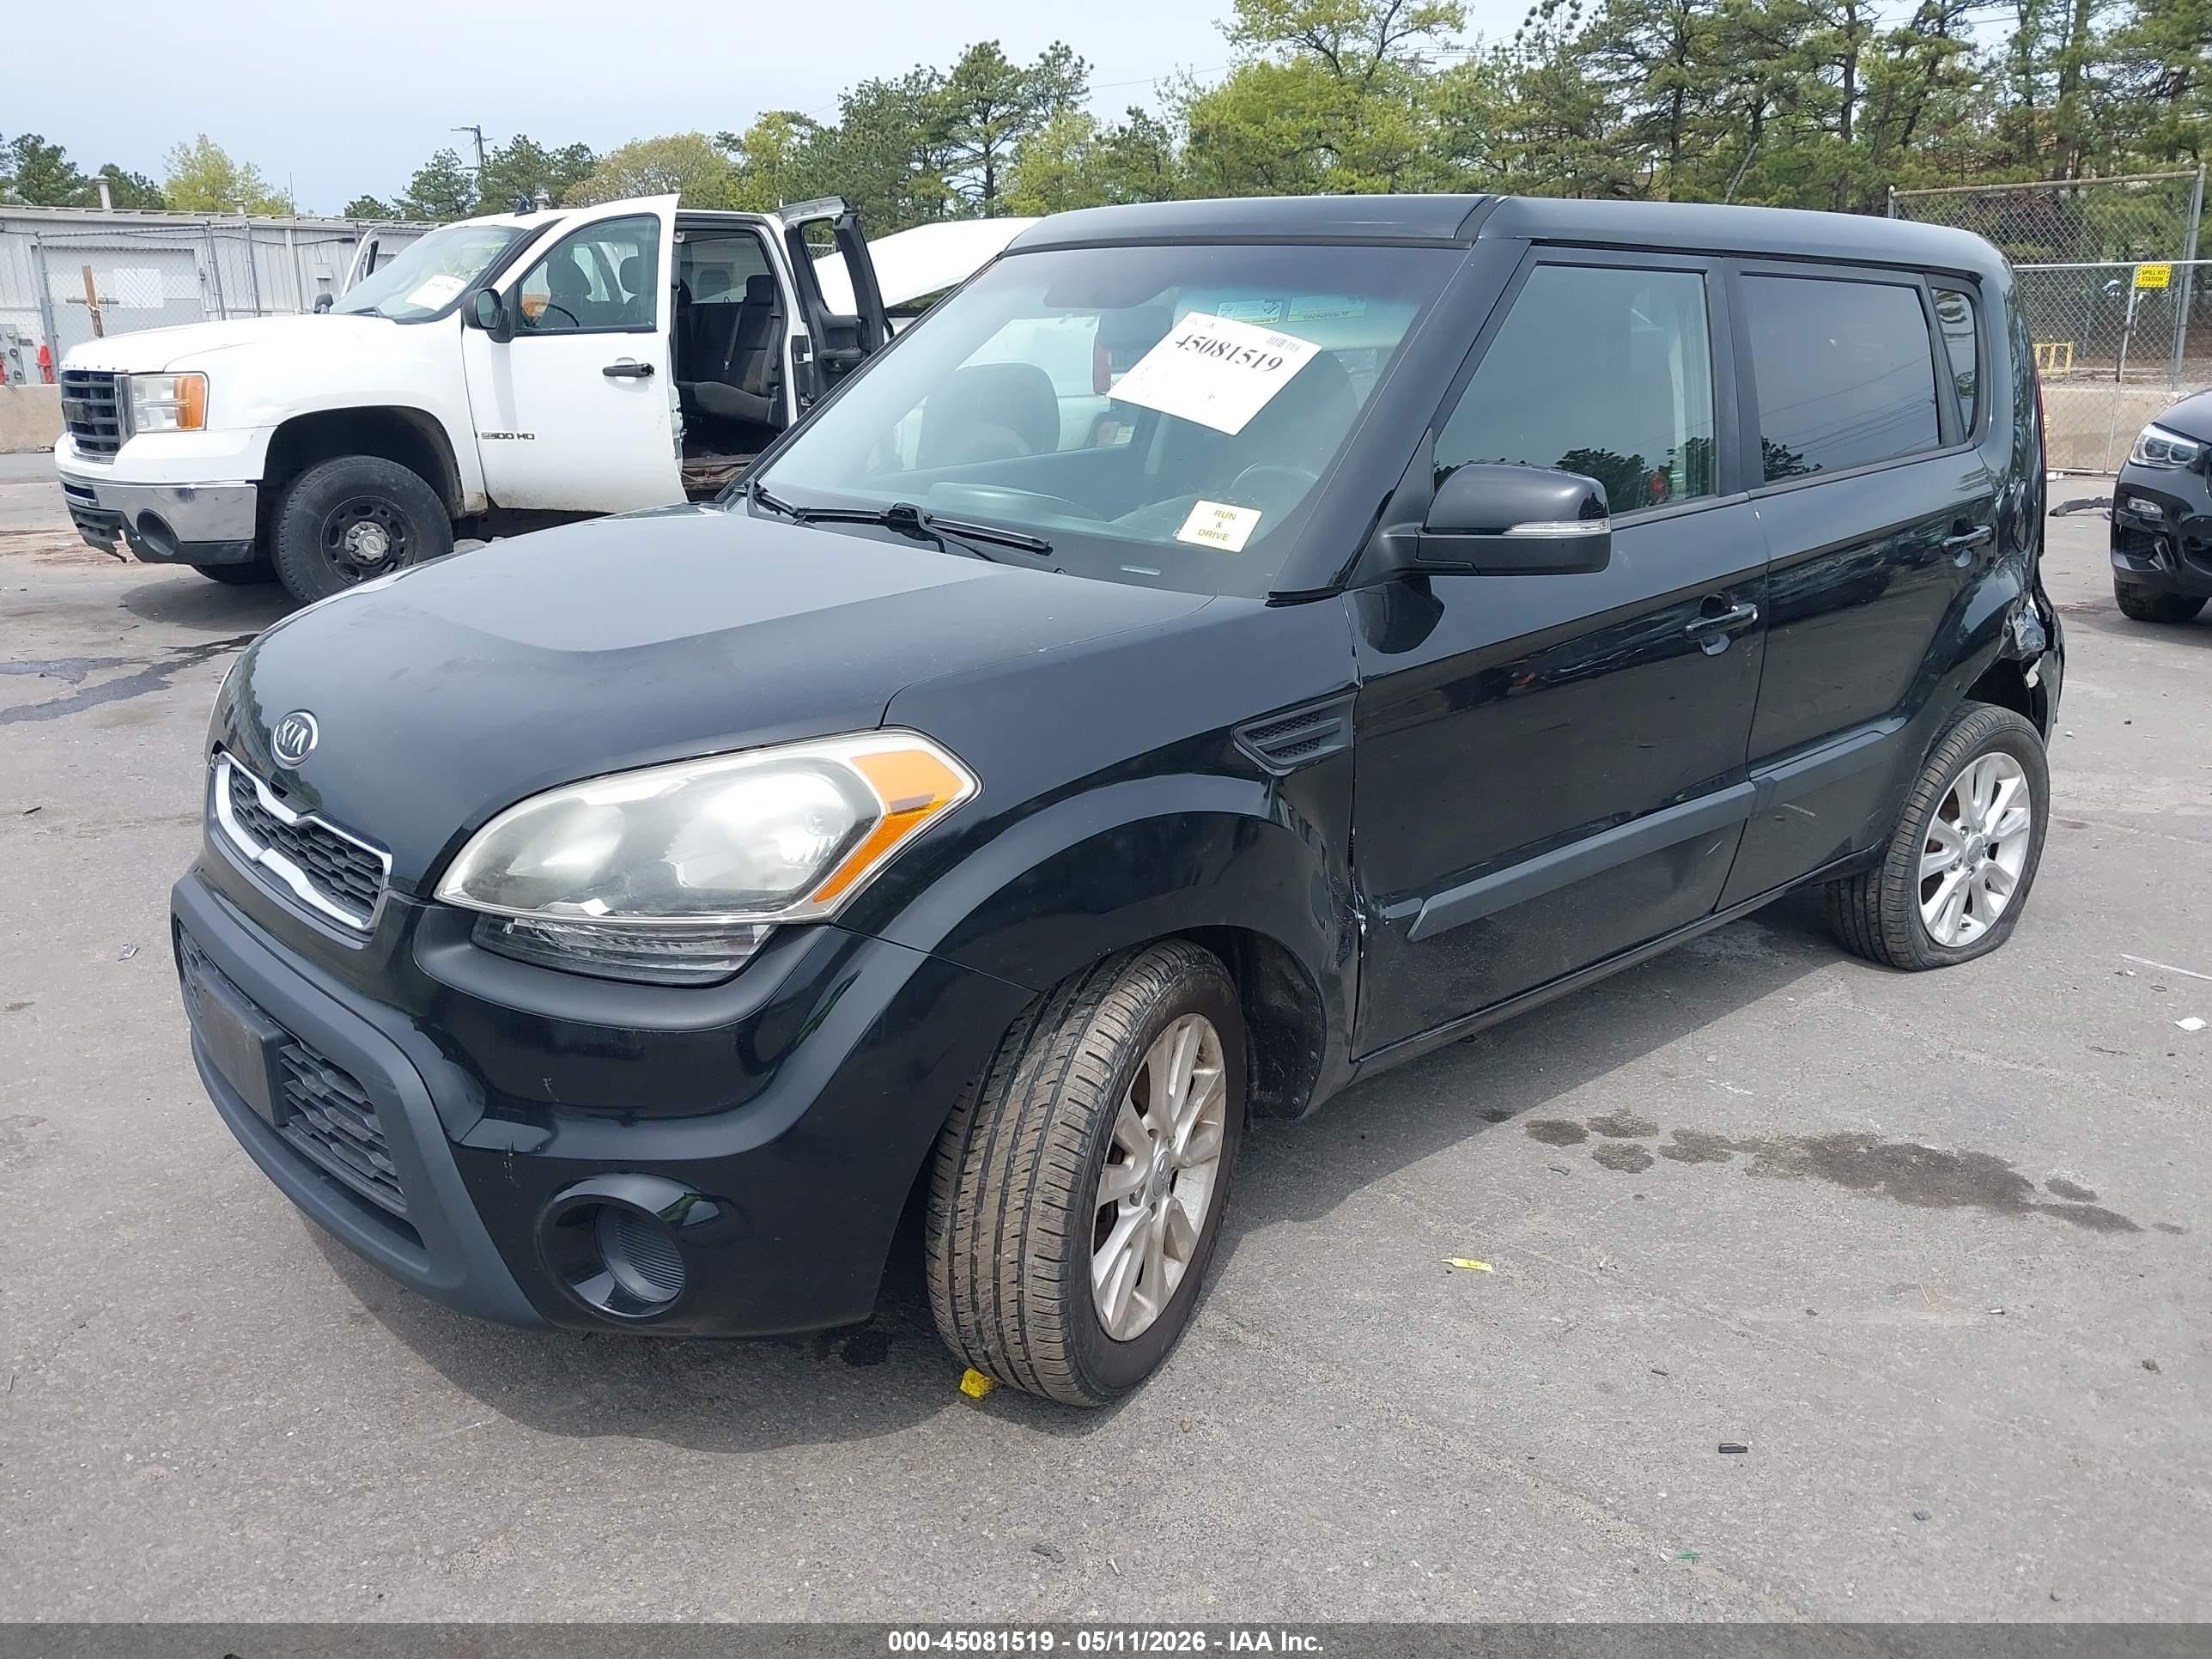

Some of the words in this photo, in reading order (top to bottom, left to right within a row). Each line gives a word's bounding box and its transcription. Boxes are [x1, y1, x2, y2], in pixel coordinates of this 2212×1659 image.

[1175, 333, 1284, 372] 45081519
[1213, 510, 1237, 520] RUN
[1197, 528, 1231, 541] DRIVE
